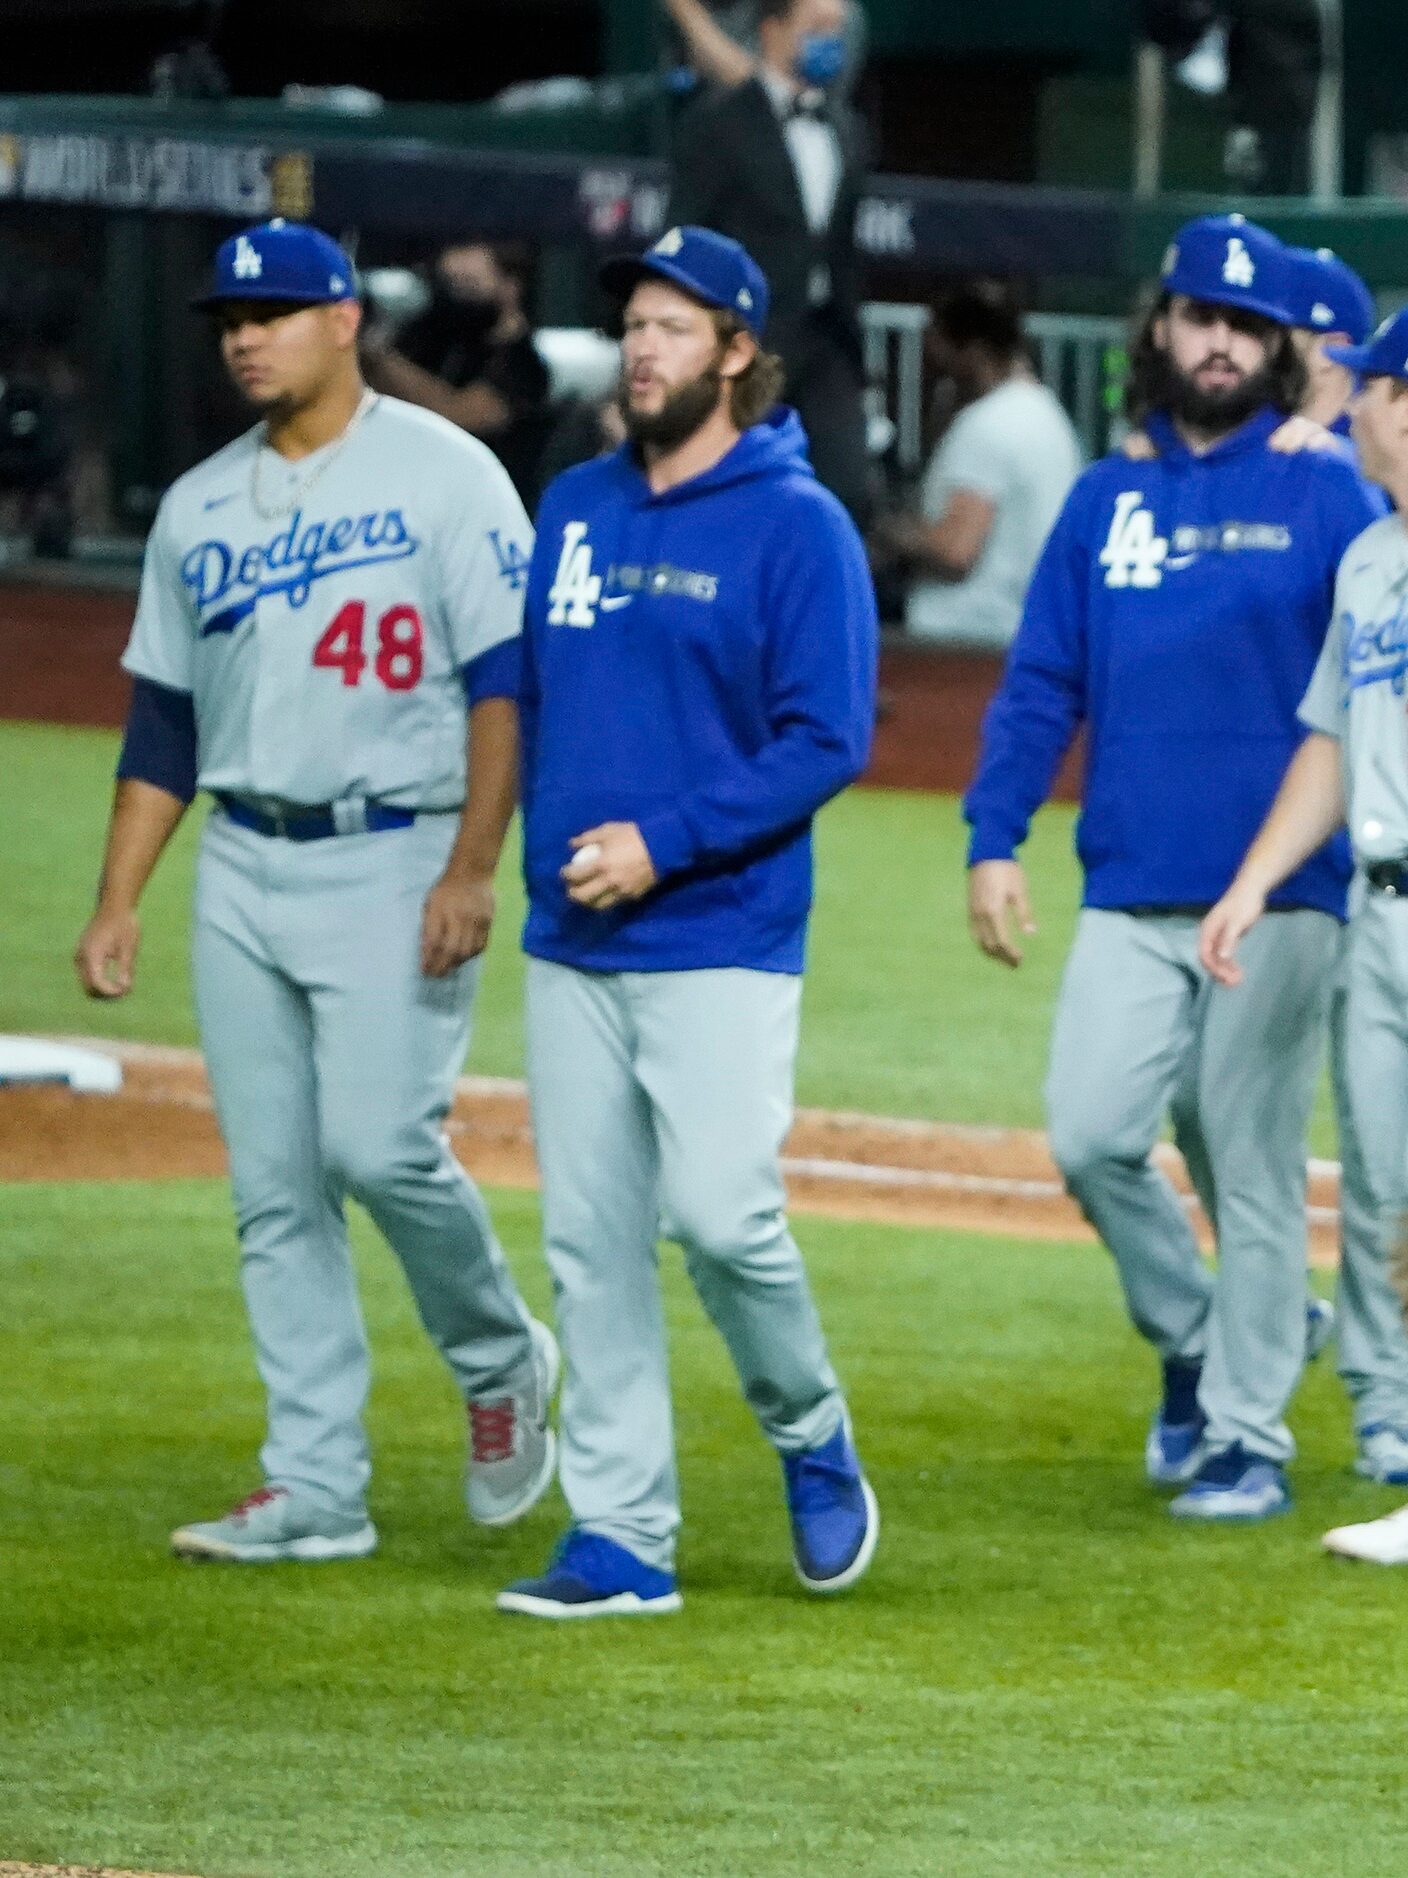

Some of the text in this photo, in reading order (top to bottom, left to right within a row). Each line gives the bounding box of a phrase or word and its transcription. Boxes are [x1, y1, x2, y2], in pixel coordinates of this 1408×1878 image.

[181, 507, 418, 620] Dodgers
[547, 520, 602, 630] LA
[1098, 490, 1169, 589] LA
[312, 598, 424, 692] 48
